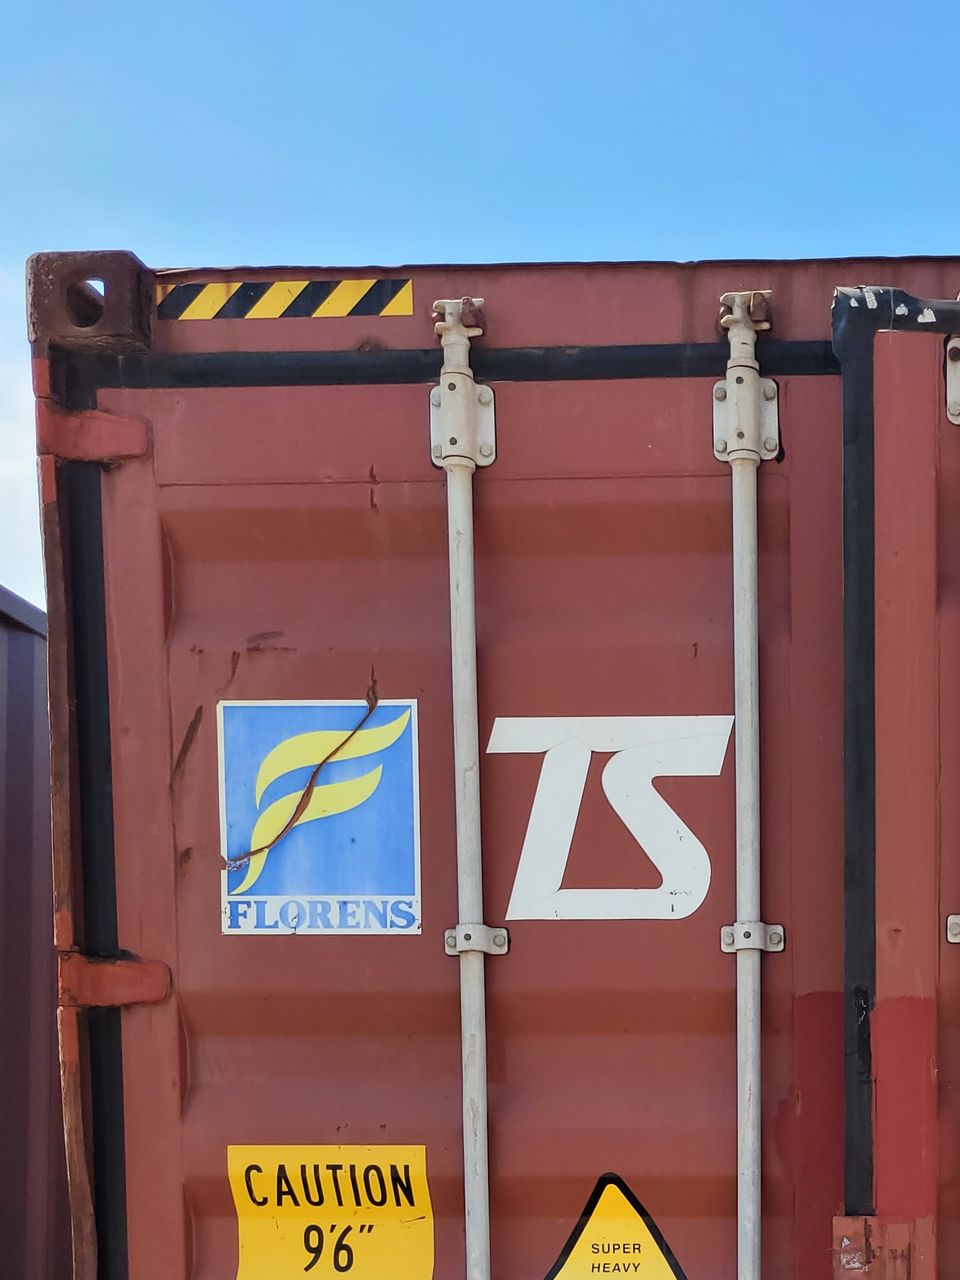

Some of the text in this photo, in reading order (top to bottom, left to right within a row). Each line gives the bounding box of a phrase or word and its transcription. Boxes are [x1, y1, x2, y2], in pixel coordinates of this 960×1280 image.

[485, 714, 736, 921] TS
[227, 900, 417, 930] FLORENS
[244, 1164, 416, 1207] CAUTION
[591, 1243, 641, 1254] SUPER
[591, 1262, 641, 1273] HEAVY
